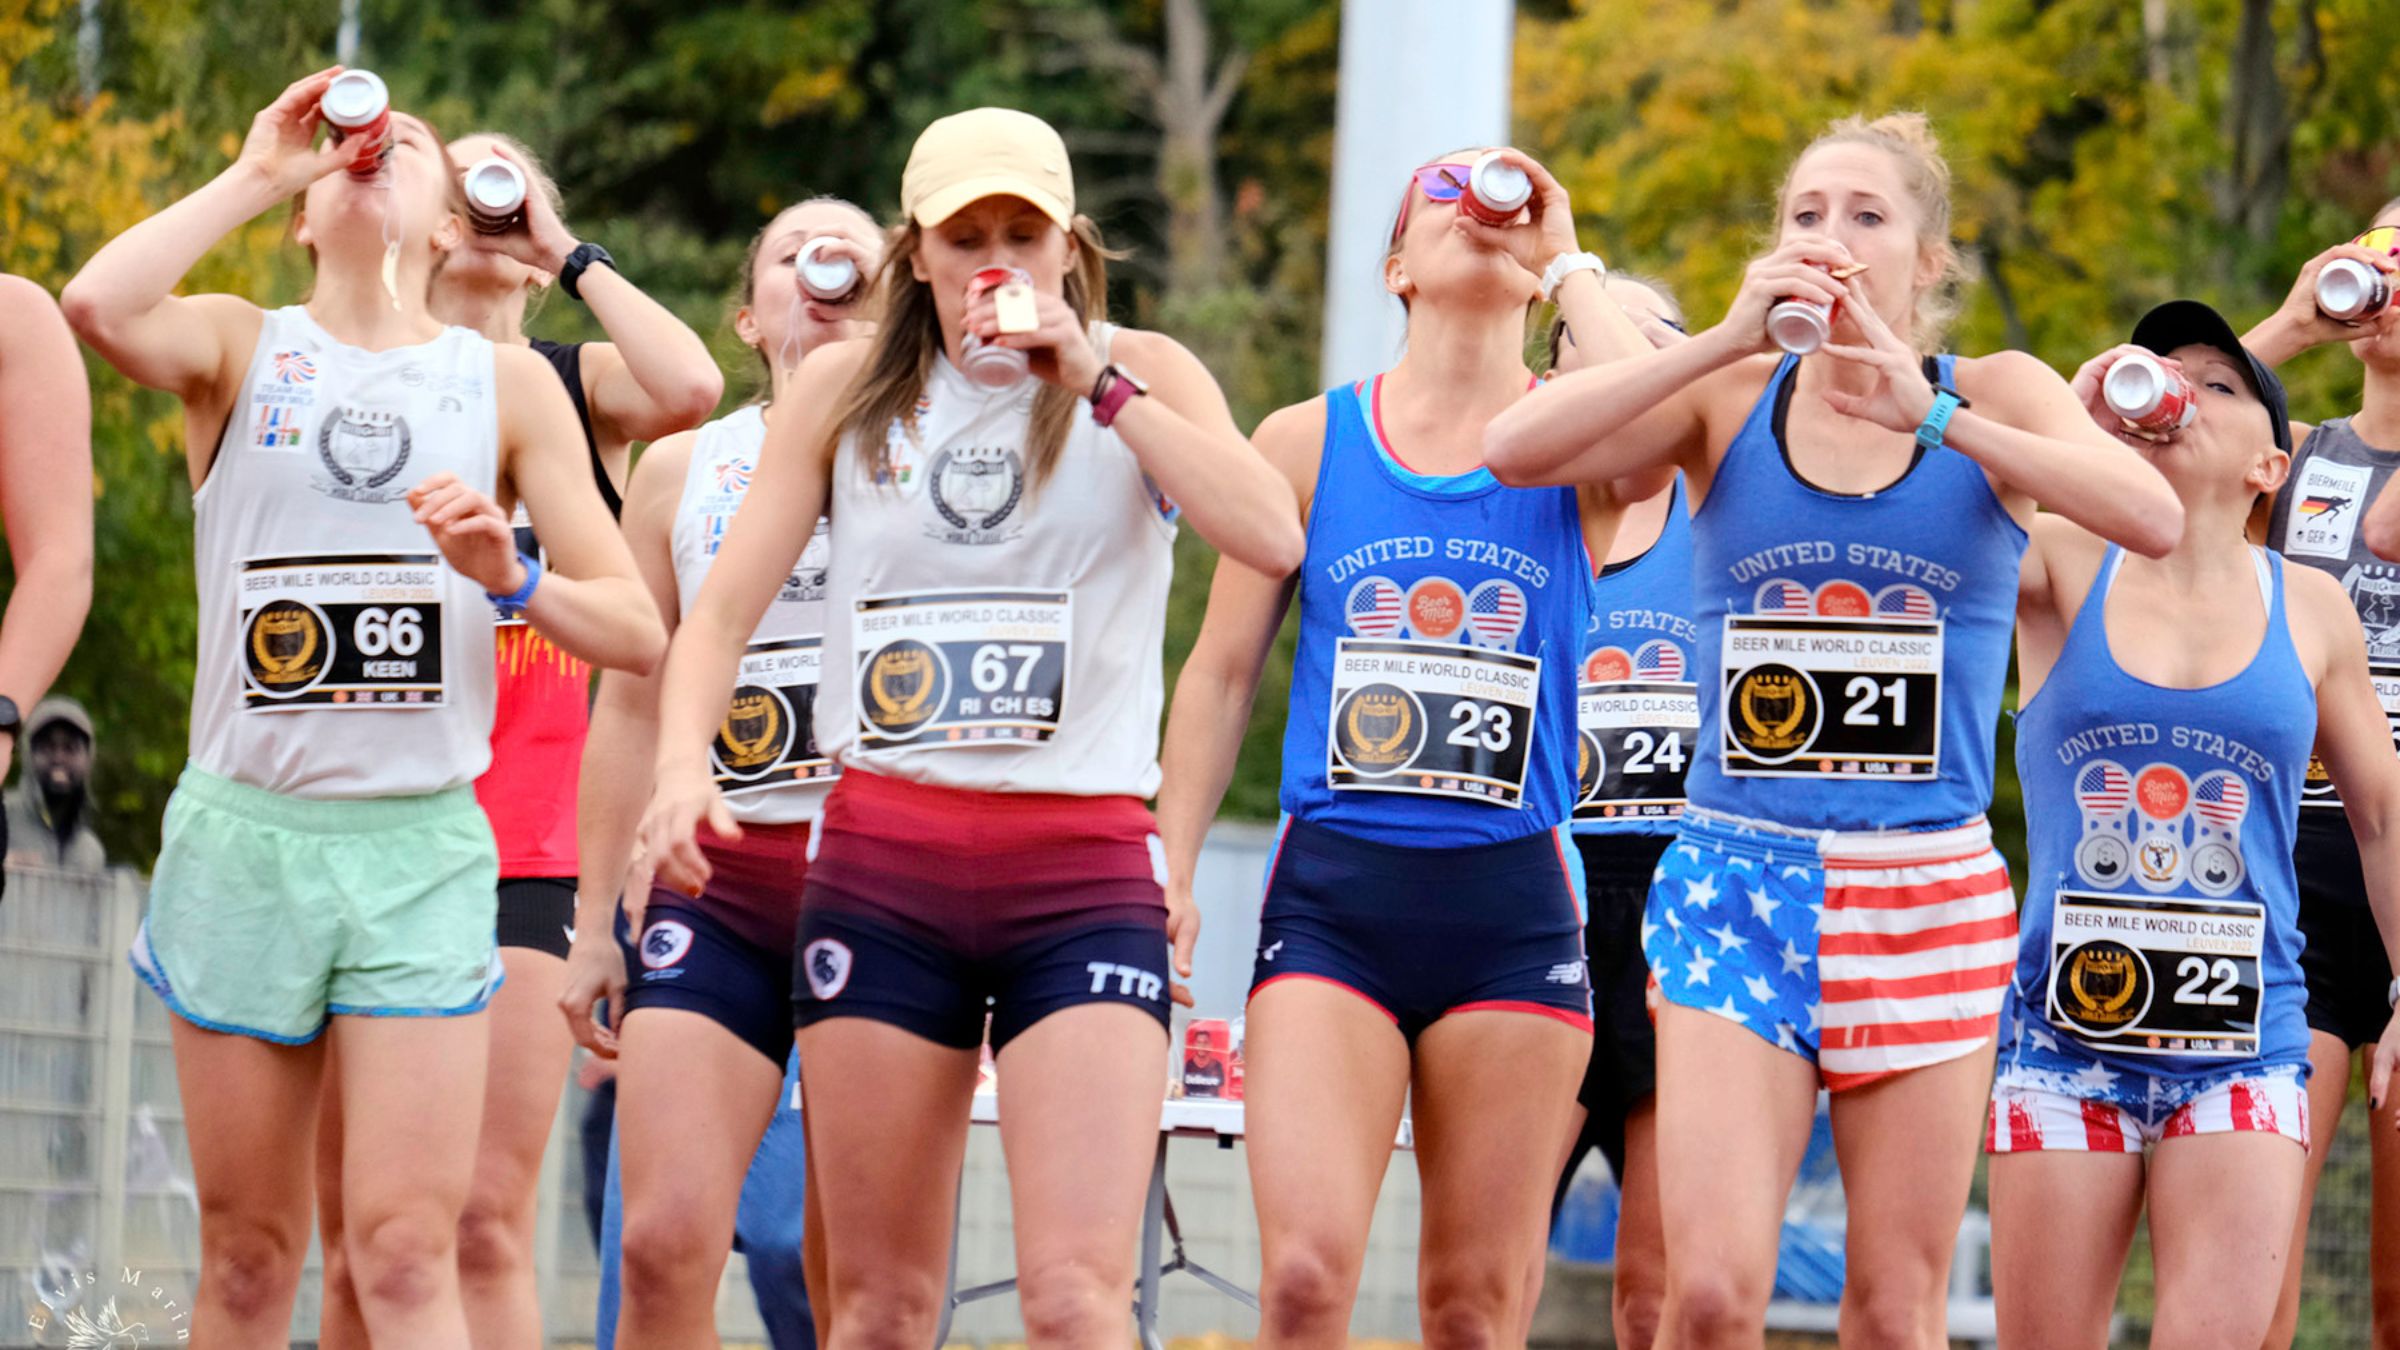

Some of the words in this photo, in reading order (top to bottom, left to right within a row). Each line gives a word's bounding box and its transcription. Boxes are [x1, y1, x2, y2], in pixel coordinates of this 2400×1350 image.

[2306, 473, 2357, 493] BIERMEILE
[2306, 529, 2326, 544] GER
[1327, 536, 1434, 584] UNITED
[1445, 538, 1551, 590] STATES
[1729, 540, 1836, 584] UNITED
[1847, 543, 1962, 592] STATES
[245, 576, 277, 591] BEER
[281, 573, 315, 587] MILE
[318, 571, 372, 586] WORLD
[375, 571, 436, 586] CLASSIC
[863, 616, 898, 632] BEER
[901, 611, 934, 627] MILE
[938, 609, 993, 624] WORLD
[996, 609, 1062, 624] CLASSIC
[1608, 609, 1698, 644] STATES
[354, 606, 424, 657] 66
[1733, 637, 1769, 651] BEER
[1773, 638, 1806, 652] MILE
[1810, 638, 1865, 654] WORLD
[1868, 640, 1932, 655] CLASSIC
[362, 660, 417, 678] KEEN
[744, 658, 774, 673] MILE
[777, 655, 821, 669] WORL
[971, 643, 1045, 693] 67
[1344, 659, 1380, 672] BEER
[1383, 660, 1415, 674] MILE
[1419, 661, 1472, 679] WORLD
[1475, 668, 1531, 689] CLASSIC
[1853, 658, 1900, 669] LEUVEN
[1903, 659, 1931, 670] 2022
[380, 693, 399, 703] UK
[1460, 682, 1502, 698] LEUVEN
[2375, 682, 2400, 697] RLD
[1591, 699, 1638, 713] WORLD
[1642, 699, 1697, 713] CLASSIC
[1842, 676, 1907, 727] 21
[1446, 700, 1513, 752] 23
[1622, 731, 1686, 774] 24
[2057, 723, 2159, 766] UNITED
[2171, 726, 2275, 783] STATES
[1864, 762, 1889, 773] USA
[1463, 781, 1486, 794] USA
[1643, 805, 1665, 815] USA
[2064, 913, 2103, 928] BEER
[2107, 915, 2140, 930] MILE
[2145, 918, 2197, 935] WORLD
[2201, 921, 2256, 938] CLASSIC
[2187, 938, 2229, 950] LEUVEN
[2231, 940, 2253, 951] 2022
[1087, 961, 1163, 1001] TTR
[2173, 956, 2240, 1006] 22
[2190, 1040, 2213, 1050] USA
